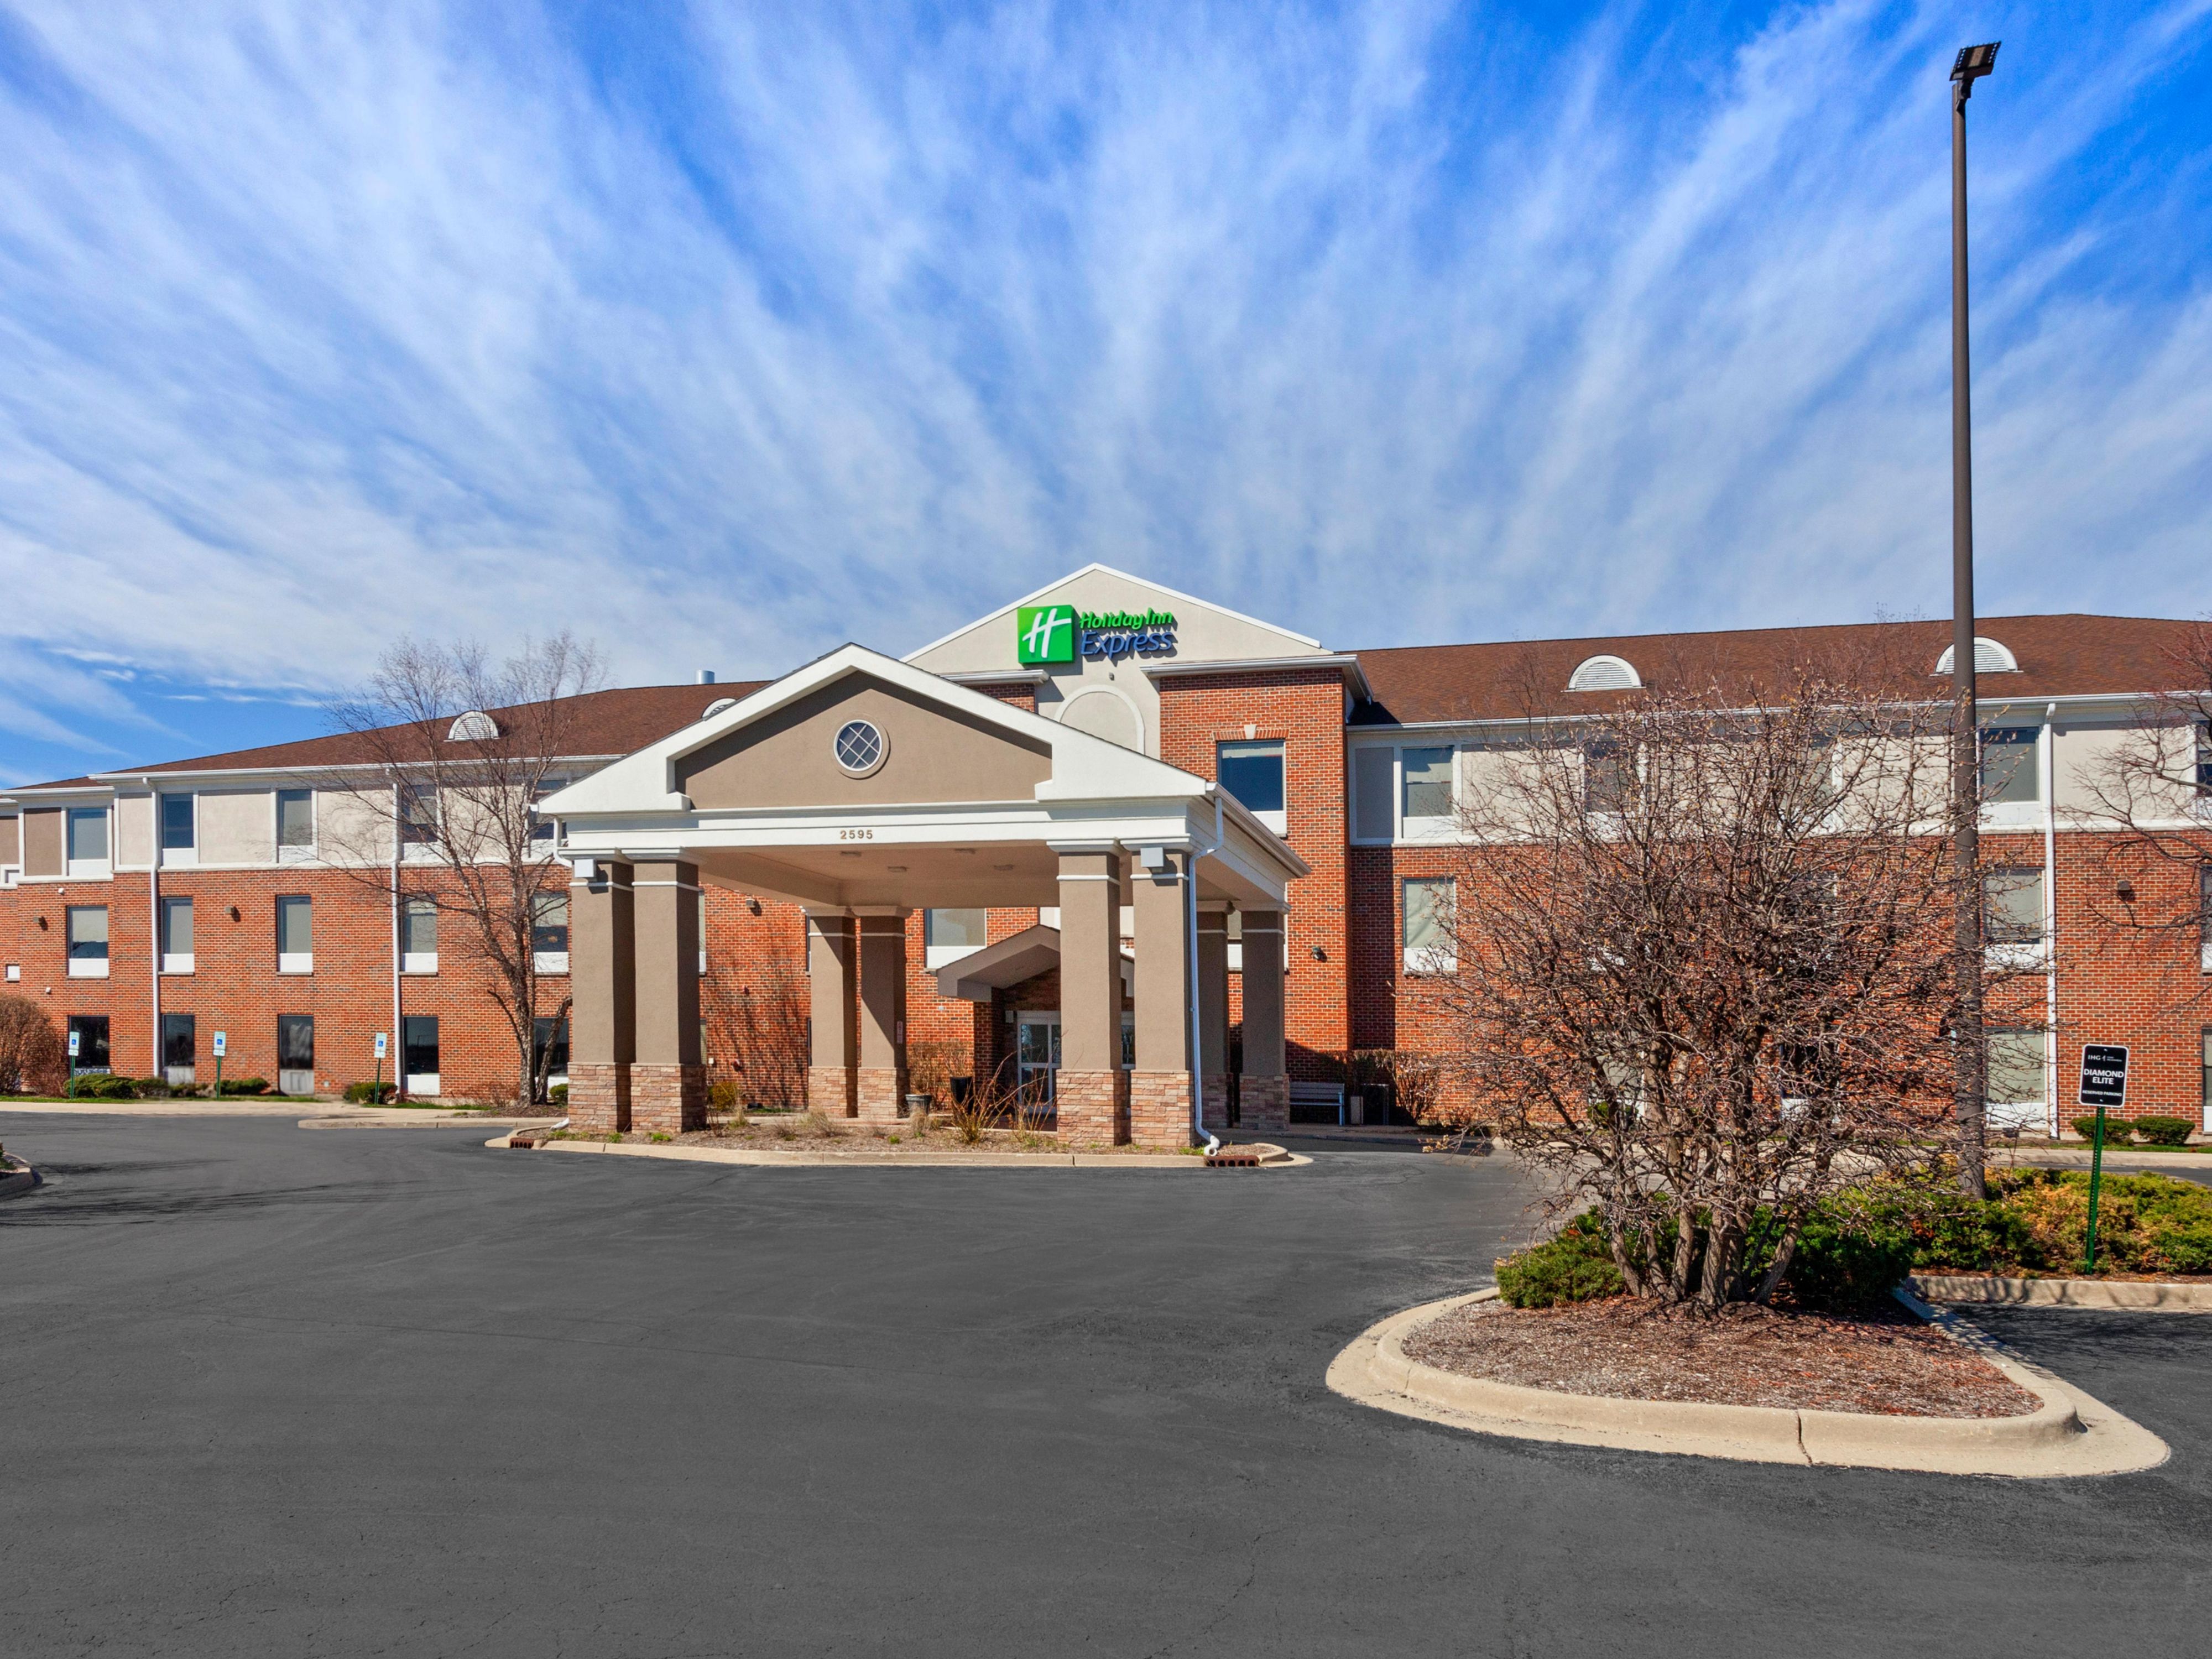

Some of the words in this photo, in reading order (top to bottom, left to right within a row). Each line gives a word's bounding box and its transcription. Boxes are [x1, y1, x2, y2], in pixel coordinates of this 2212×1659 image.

[1079, 610, 1142, 630] Holiday
[1145, 607, 1173, 625] Inn
[1022, 608, 1072, 658] H
[1081, 630, 1173, 659] Express
[840, 830, 873, 839] 2595
[2084, 1068, 2124, 1078] DIAMOND
